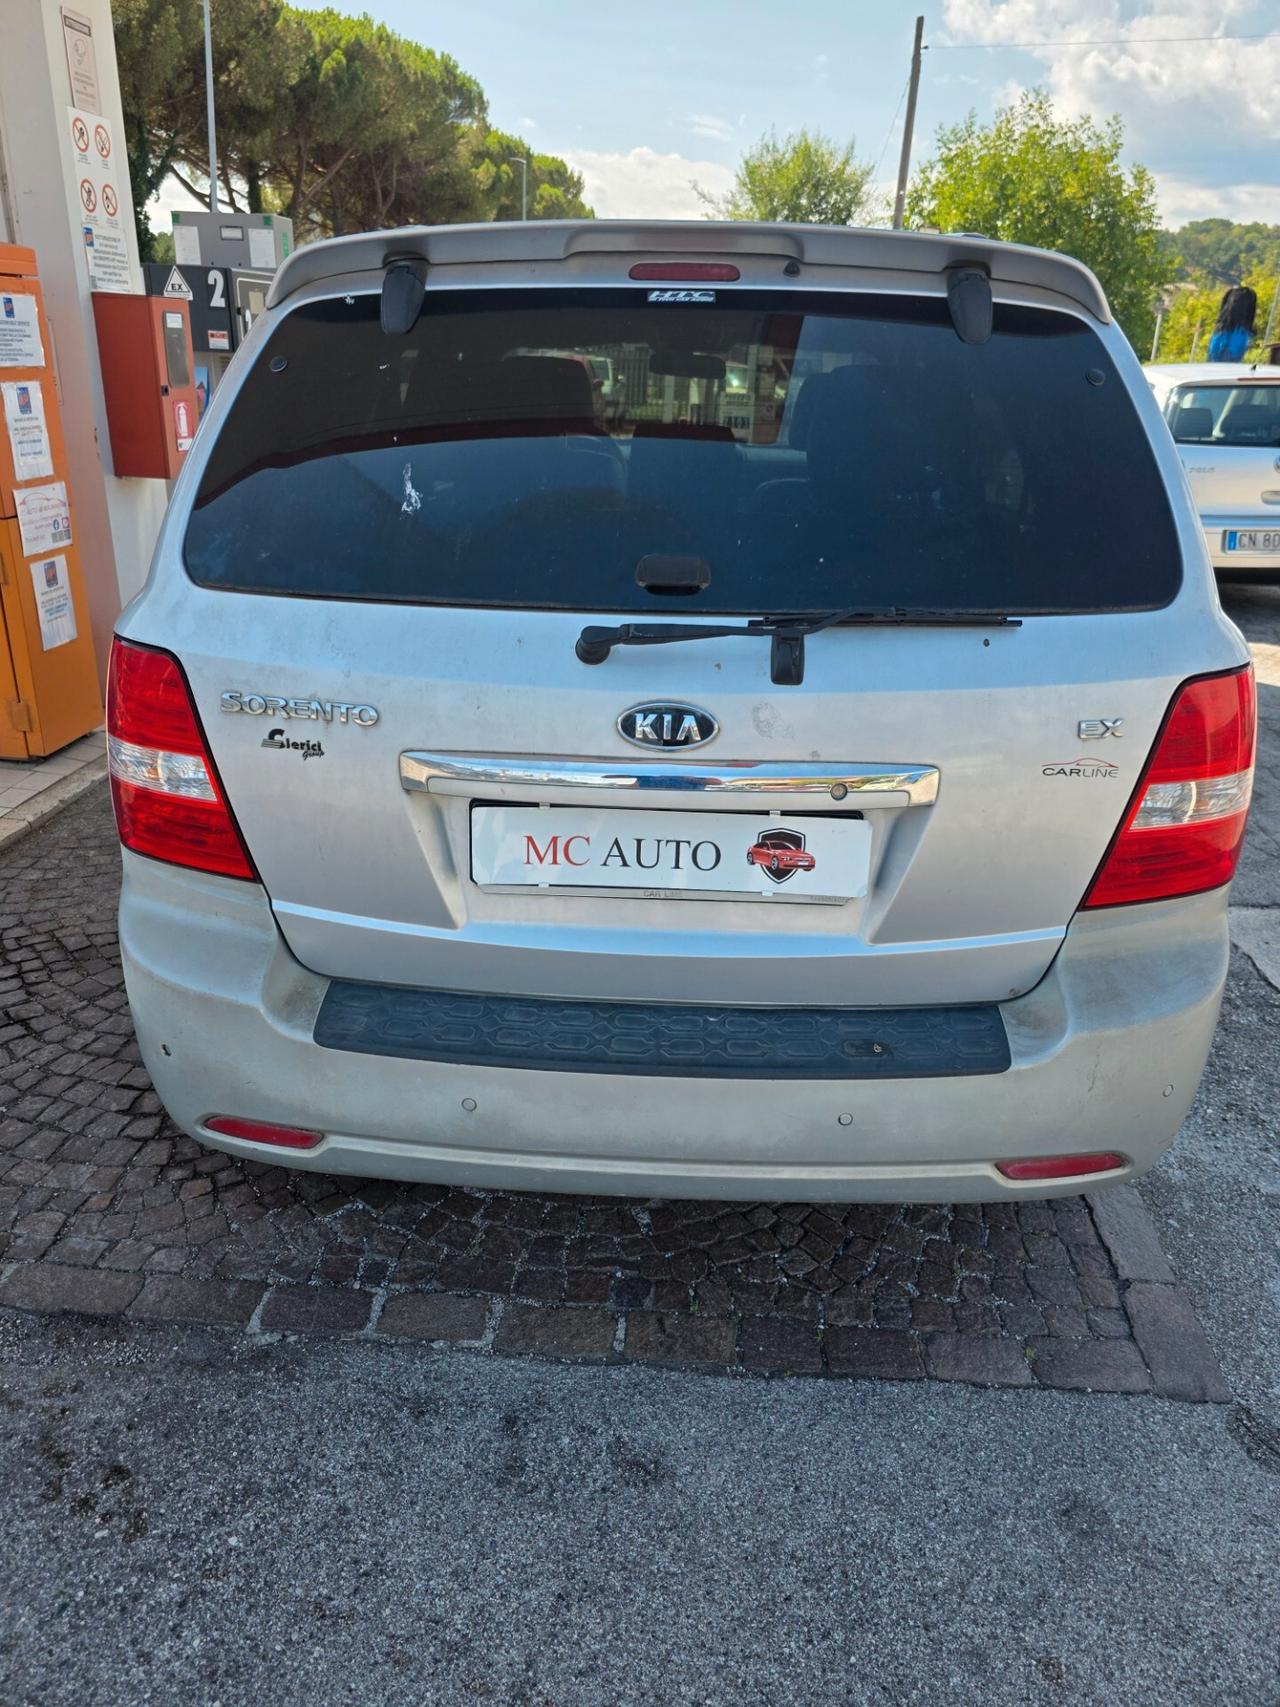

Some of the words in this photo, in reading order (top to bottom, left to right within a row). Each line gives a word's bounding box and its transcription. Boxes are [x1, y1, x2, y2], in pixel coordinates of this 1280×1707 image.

[171, 283, 183, 291] EX
[208, 269, 226, 307] 2
[1239, 533, 1257, 548] CN
[220, 691, 379, 727] SORENTO
[634, 712, 702, 741] KIA
[1078, 718, 1125, 739] EX
[1042, 767, 1119, 778] CARLINE
[523, 834, 591, 866] MC
[602, 837, 722, 872] AUTO
